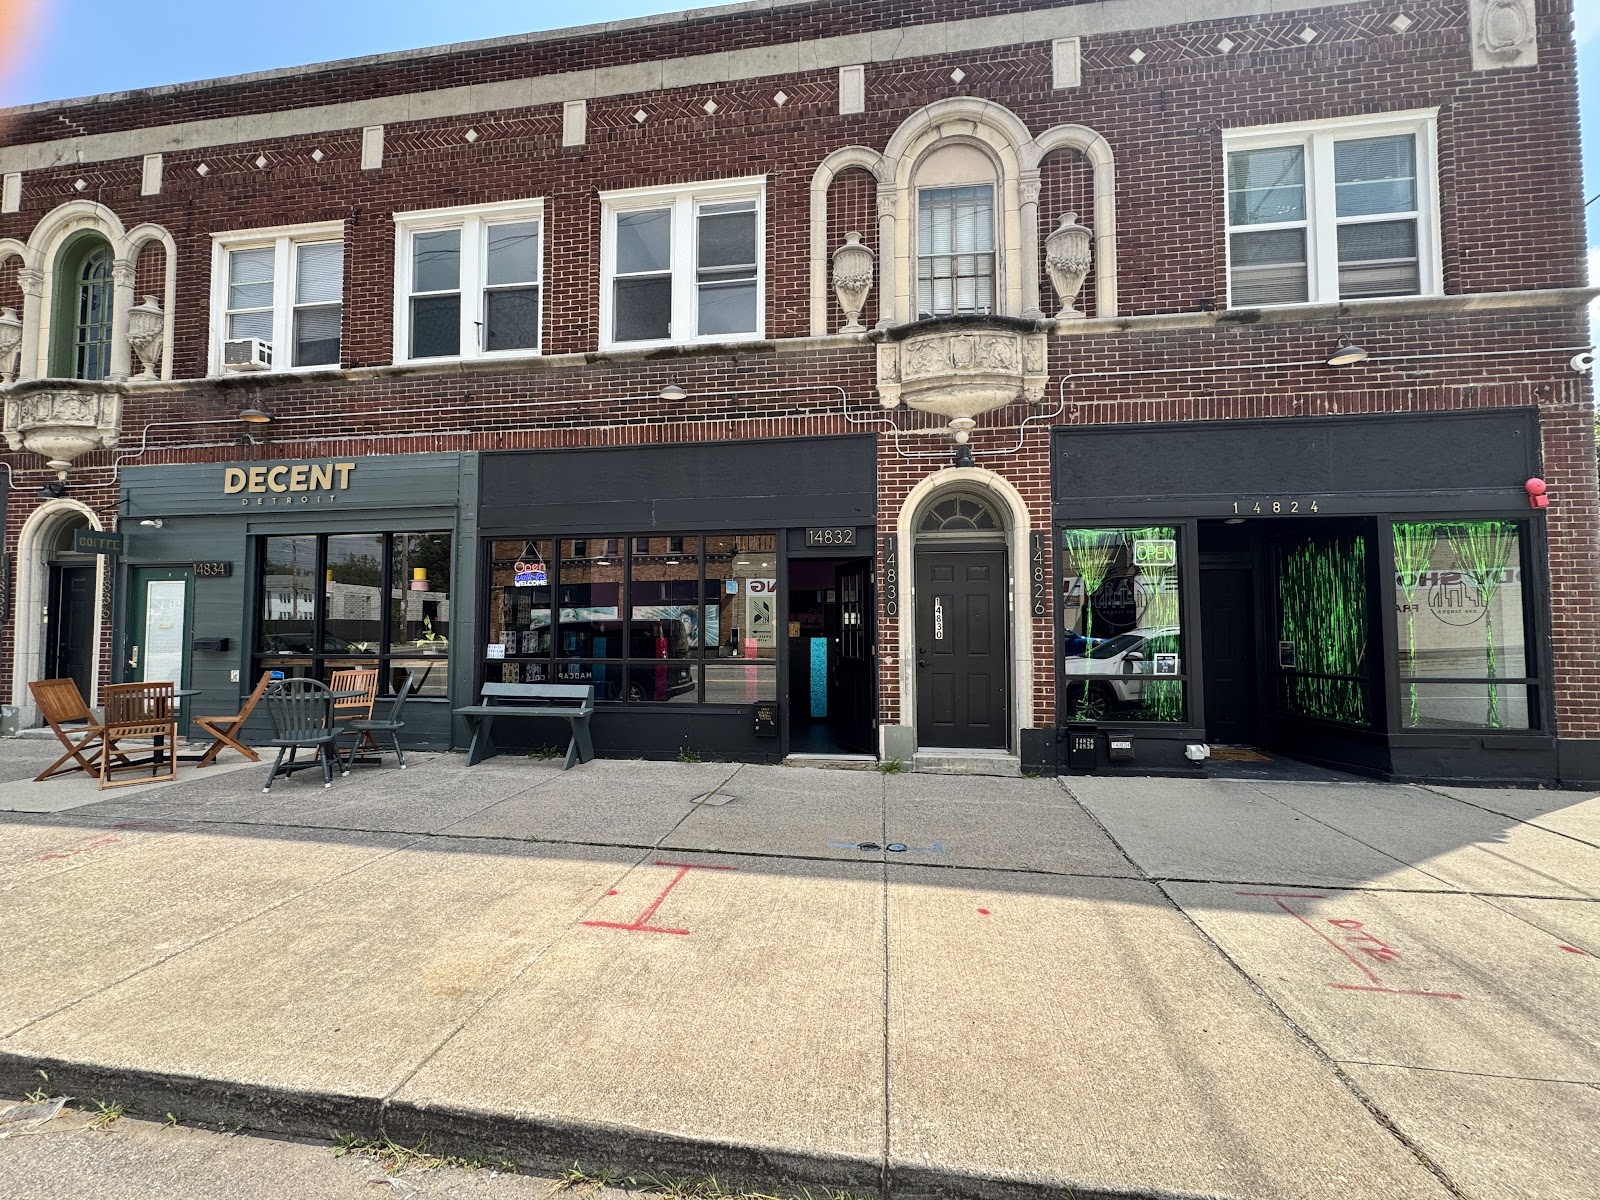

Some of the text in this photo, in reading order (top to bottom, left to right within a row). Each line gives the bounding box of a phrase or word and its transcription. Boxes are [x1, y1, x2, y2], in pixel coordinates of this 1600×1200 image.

[223, 462, 356, 494] DECENT
[242, 494, 335, 506] DETROIT
[1232, 500, 1319, 514] 14824
[79, 536, 120, 550] COFFEE
[809, 529, 853, 544] 14832
[1136, 545, 1173, 561] OPEN
[193, 562, 225, 576] 14834
[514, 561, 547, 573] Open
[886, 537, 897, 616] 14830
[1033, 534, 1045, 615] 14826
[514, 579, 547, 587] WELCOME
[934, 597, 943, 639] 14830
